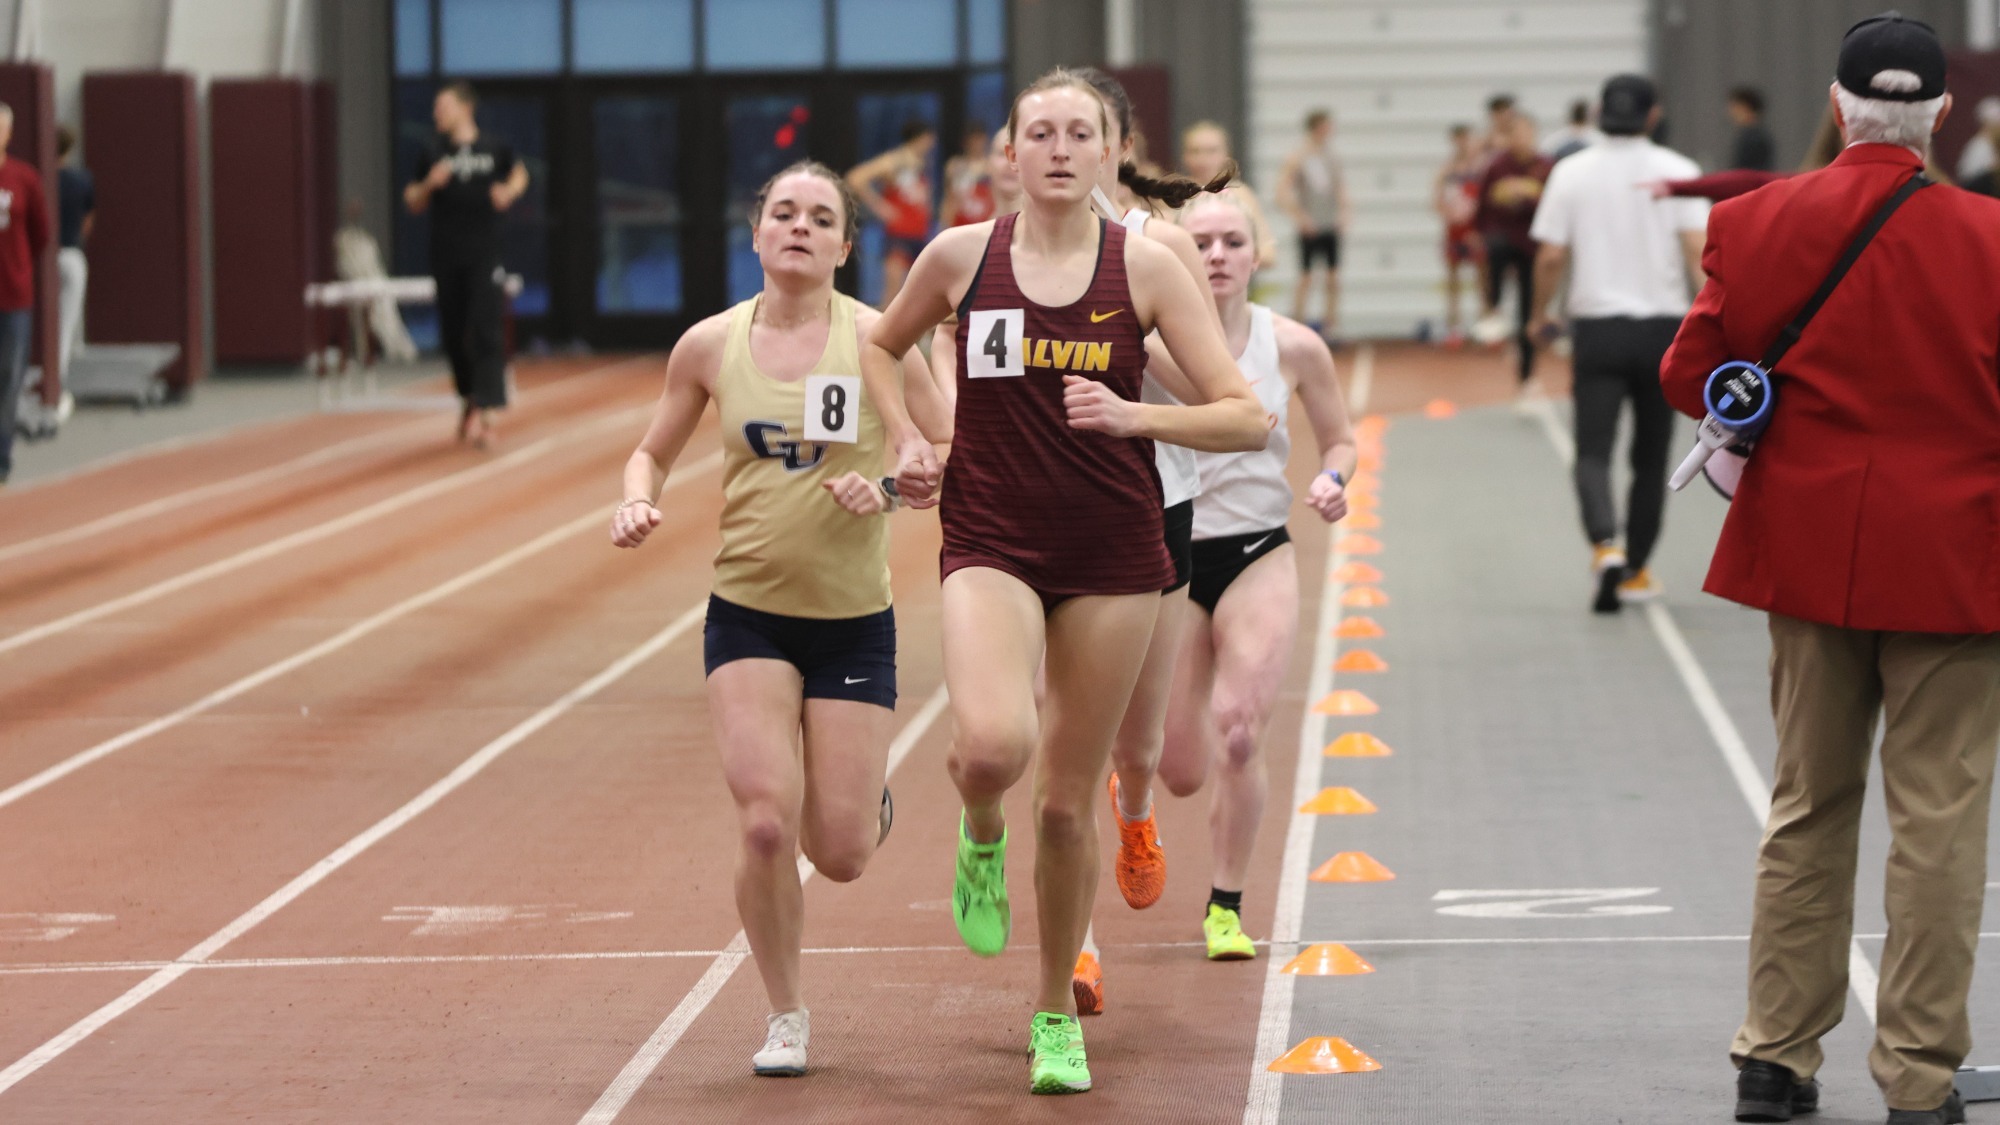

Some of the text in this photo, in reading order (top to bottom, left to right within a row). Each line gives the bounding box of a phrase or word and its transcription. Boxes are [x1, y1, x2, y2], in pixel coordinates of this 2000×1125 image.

[984, 318, 1007, 368] 4
[1023, 337, 1113, 371] ALVIN
[821, 384, 846, 431] 8
